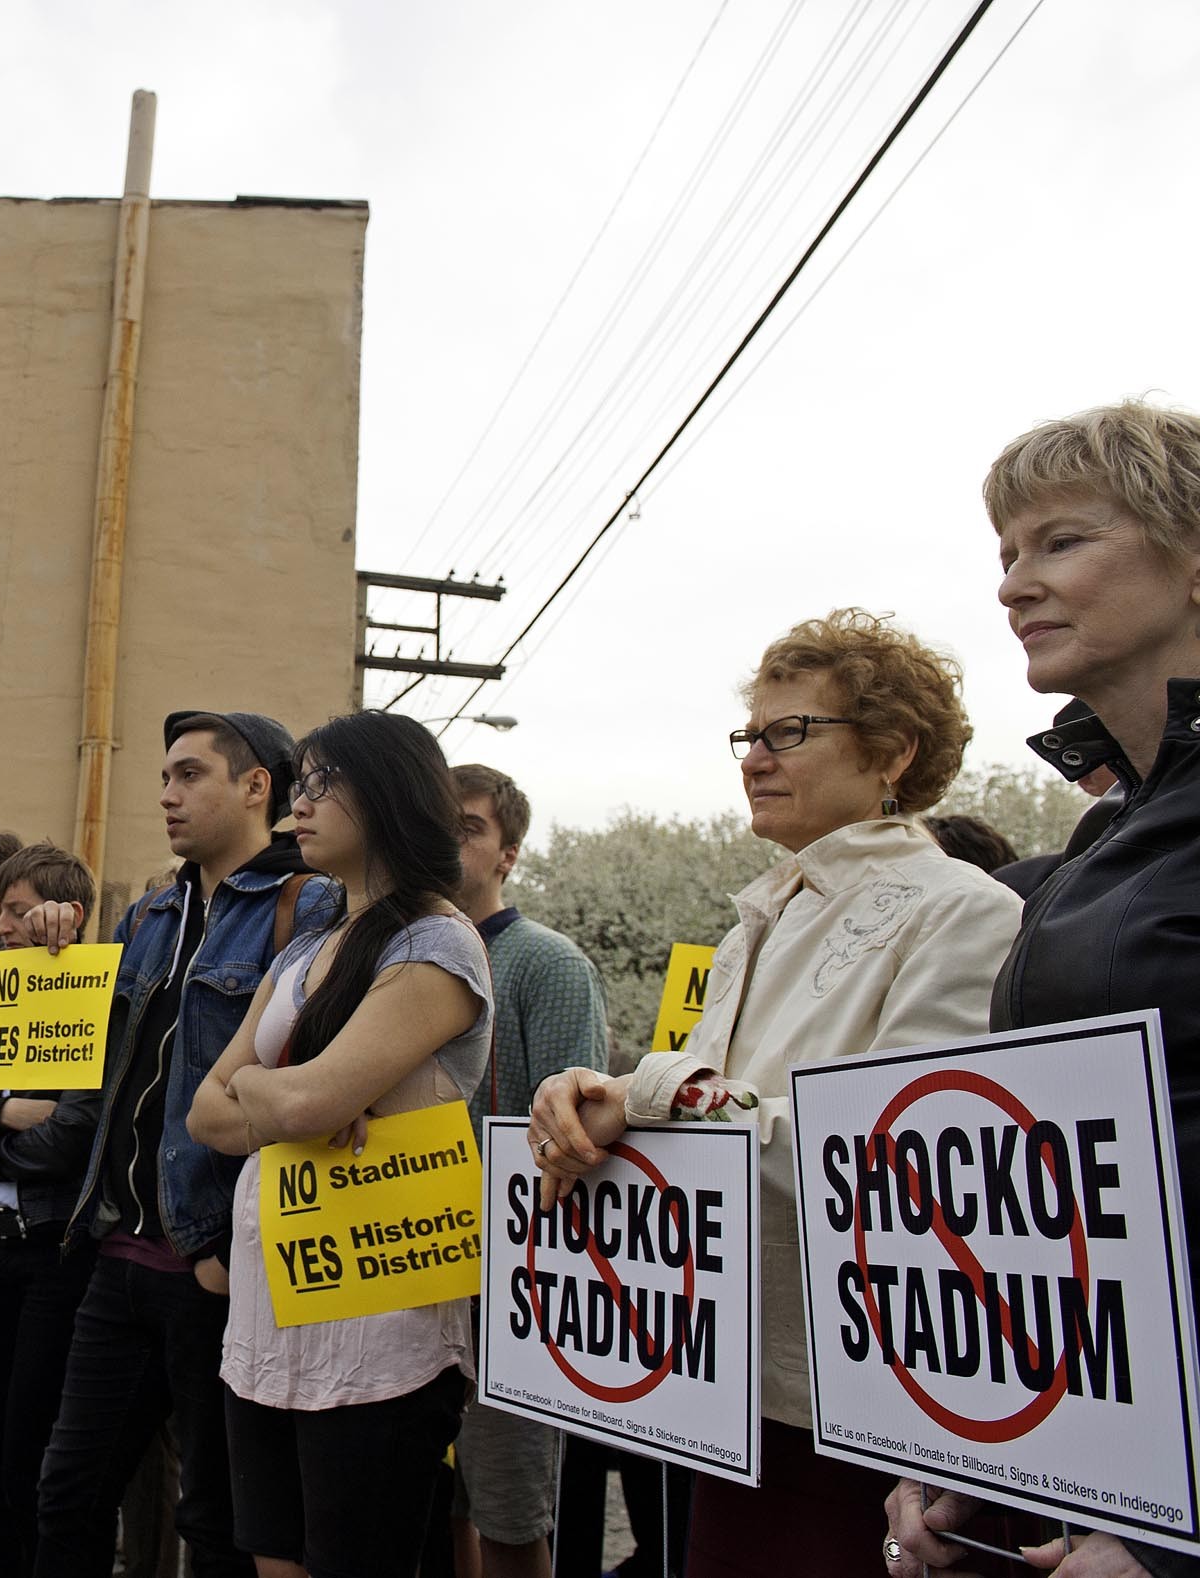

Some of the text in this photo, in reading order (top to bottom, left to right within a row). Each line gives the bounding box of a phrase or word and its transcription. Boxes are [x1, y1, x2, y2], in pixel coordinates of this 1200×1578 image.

[26, 971, 109, 993] Stadium!
[685, 966, 711, 1006] N
[25, 1043, 94, 1063] District!
[28, 1019, 95, 1039] Historic
[279, 1140, 469, 1209] NO Stadium!
[822, 1117, 1128, 1241] SHOCKOE
[276, 1207, 476, 1287] YES Historic
[356, 1234, 483, 1280] District!
[506, 1172, 724, 1274] SHOCKOE
[509, 1265, 716, 1384] STADIUM
[837, 1259, 1134, 1405] STADIUM
[490, 1380, 504, 1392] LIKE
[522, 1390, 552, 1407] Facebook
[557, 1400, 580, 1415] Donate
[581, 1406, 591, 1417] for
[592, 1409, 625, 1428] Billboard,
[626, 1419, 647, 1434] Signs
[655, 1428, 686, 1446] Stickers
[688, 1438, 698, 1449] on
[700, 1440, 742, 1463] Indiegogo
[824, 1421, 843, 1437] LIKE
[844, 1428, 854, 1440] us
[855, 1431, 866, 1443] on
[867, 1432, 908, 1453] Facebook
[914, 1443, 945, 1463] Donate
[947, 1451, 960, 1466] for
[962, 1454, 1008, 1480] Billboard,
[1009, 1466, 1039, 1486] Signs
[1042, 1474, 1050, 1488] &
[1052, 1476, 1098, 1501] Stickers
[1101, 1490, 1117, 1504] on
[1120, 1492, 1184, 1523] Indiegogo
